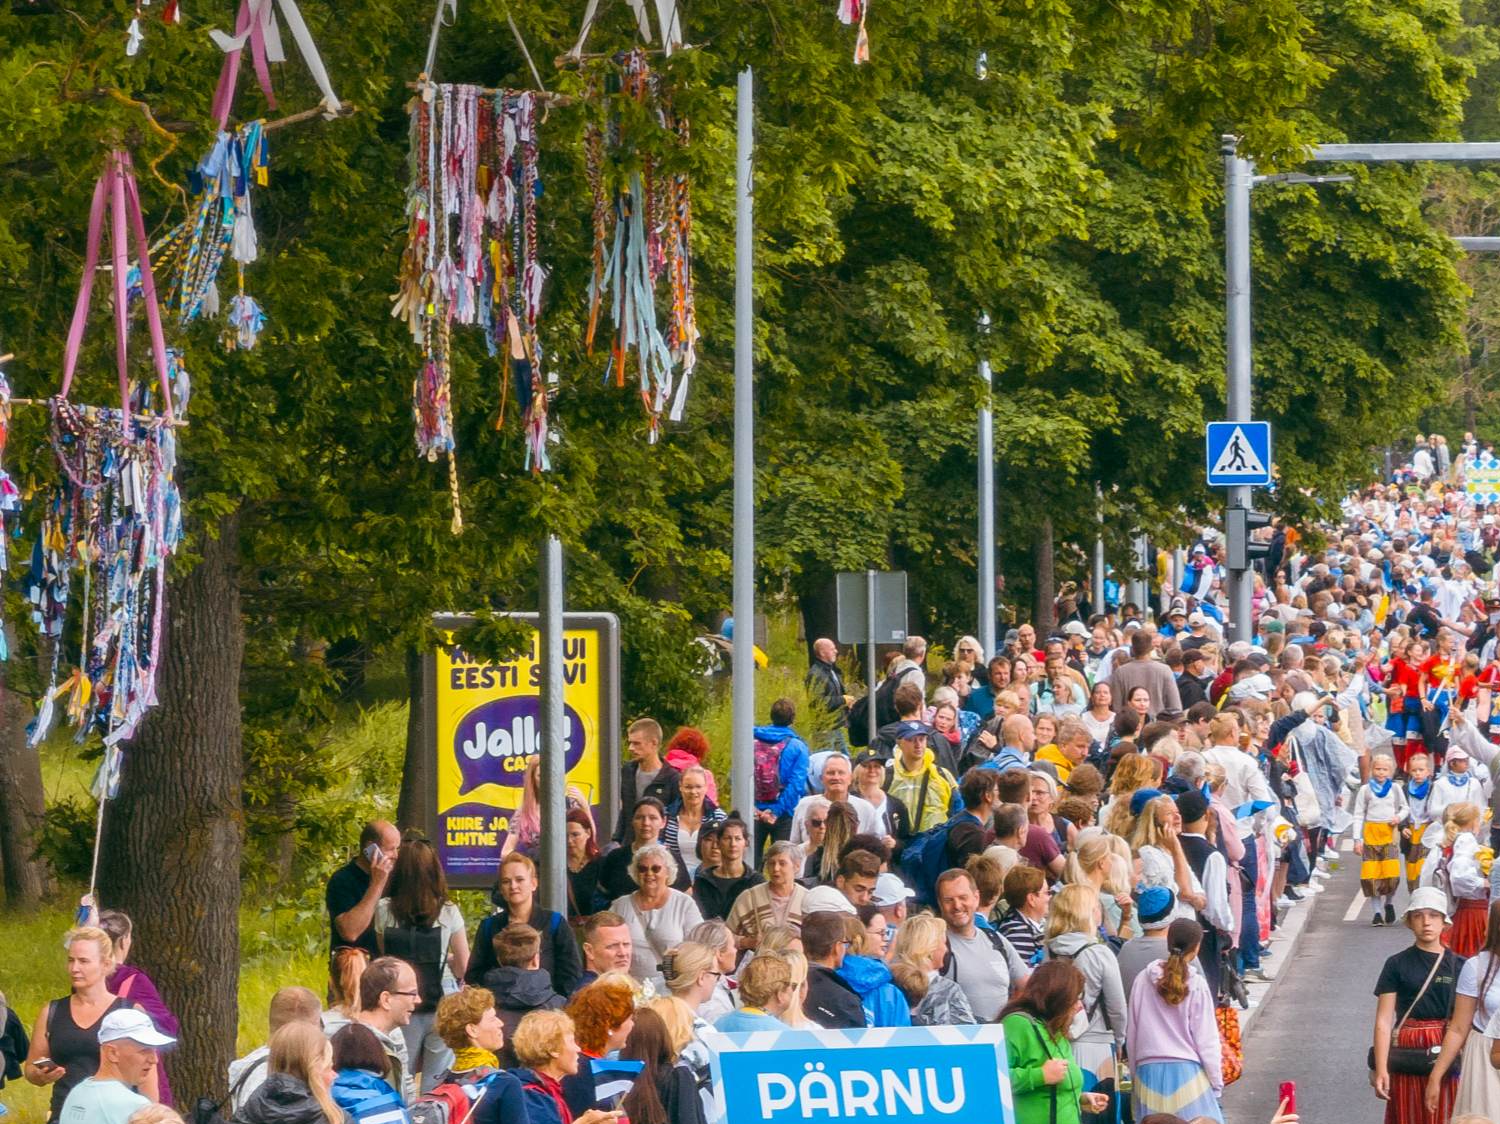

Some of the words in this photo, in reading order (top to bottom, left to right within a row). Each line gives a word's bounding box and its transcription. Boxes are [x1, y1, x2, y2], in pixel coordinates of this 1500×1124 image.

[562, 637, 587, 661] UI
[450, 664, 518, 690] EESTI
[528, 661, 587, 687] SVI
[463, 714, 572, 760] Jall!
[446, 816, 484, 831] KIIRE
[489, 816, 509, 831] JA
[446, 832, 498, 847] LIHTNE
[757, 1062, 967, 1119] PÄRNU
